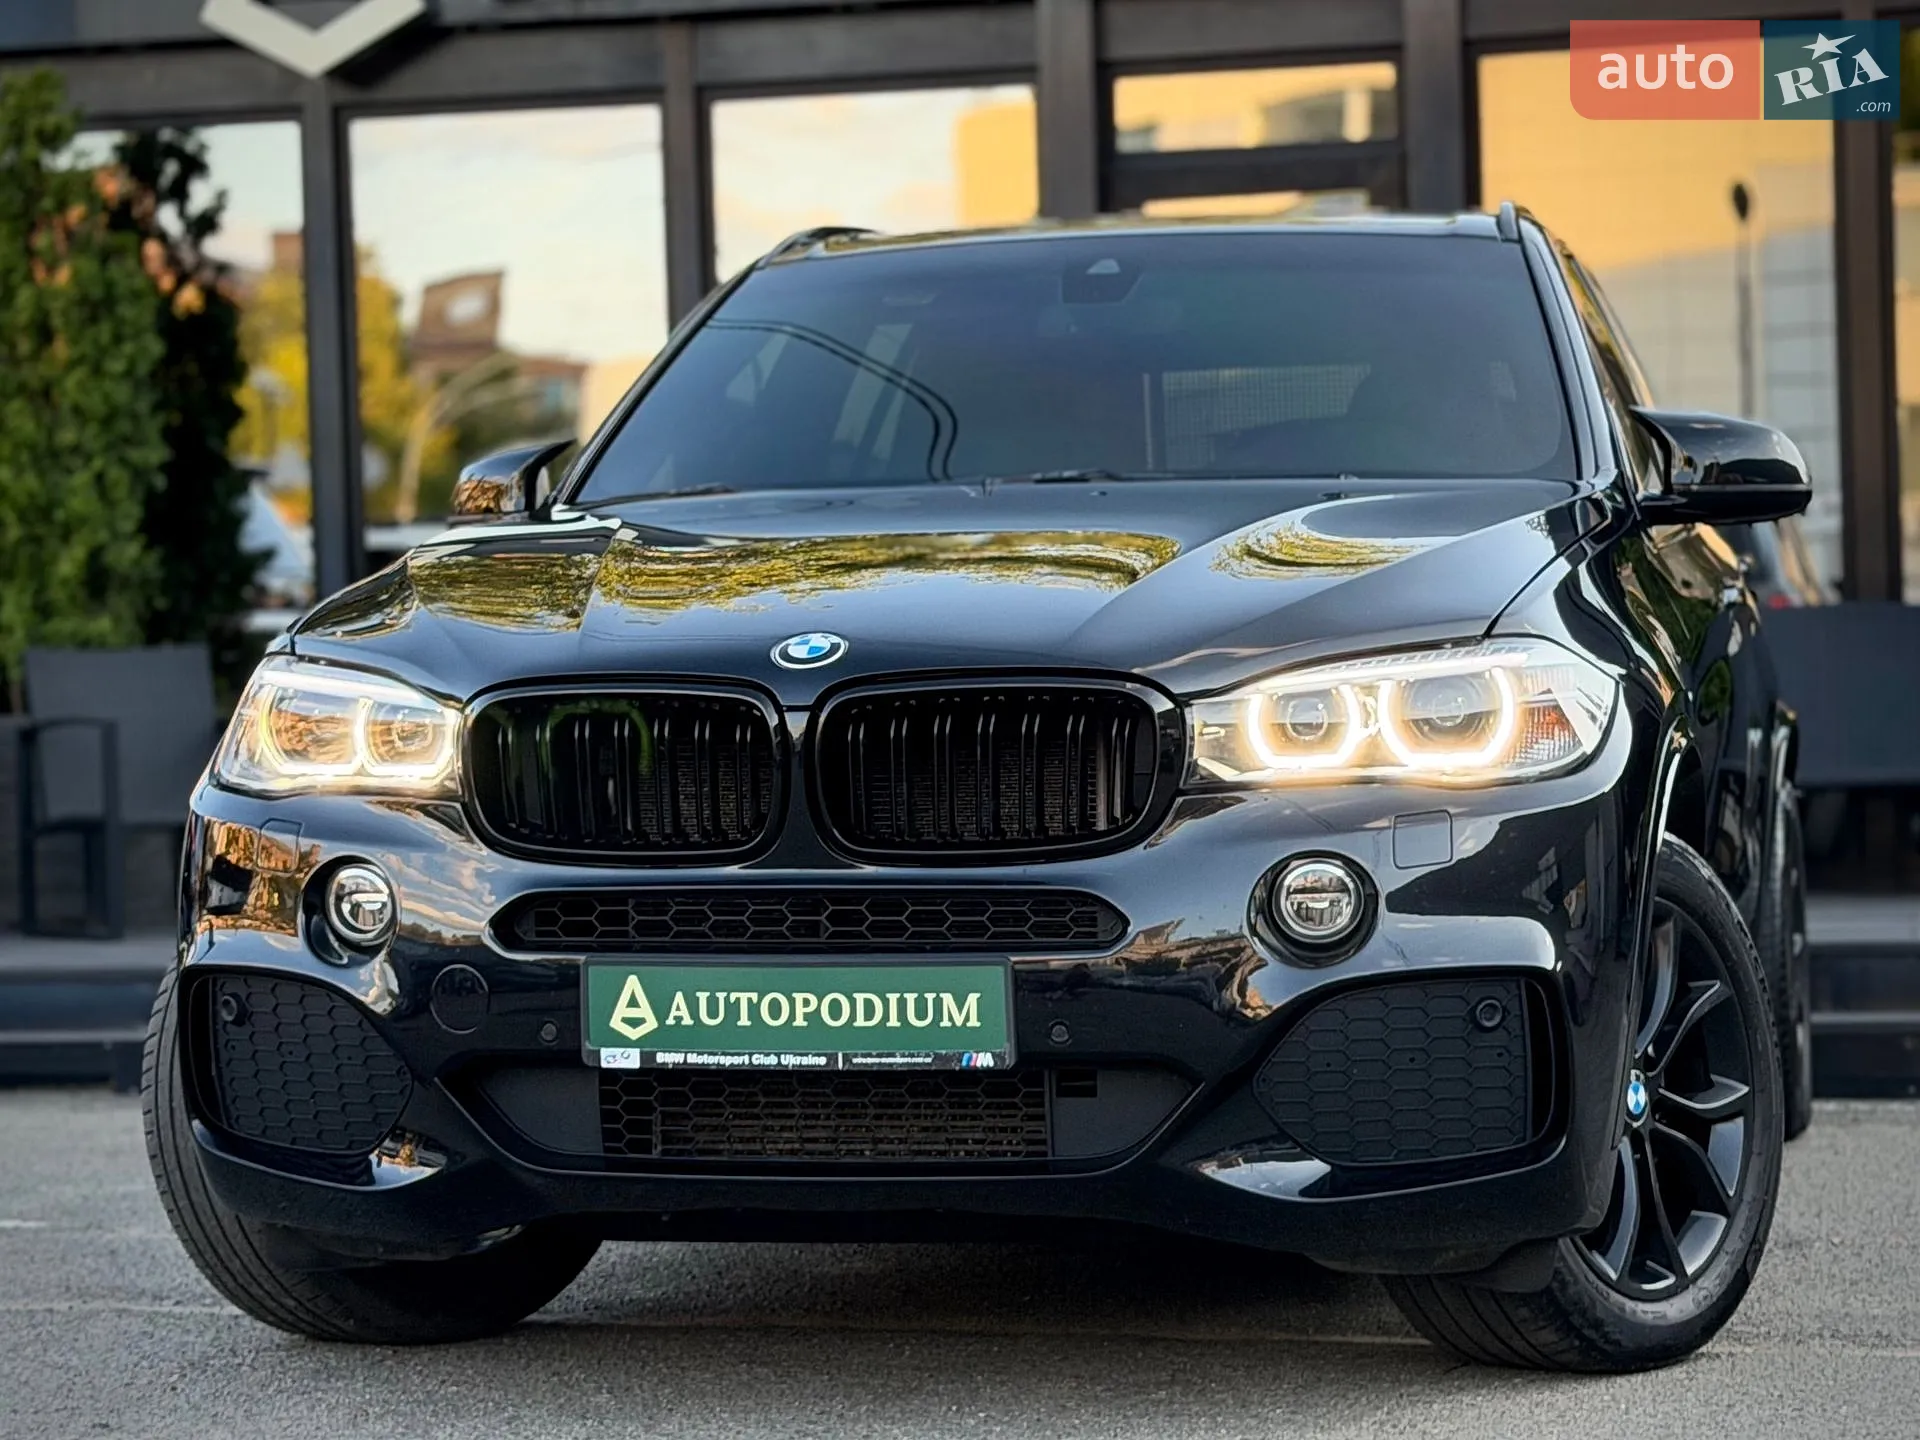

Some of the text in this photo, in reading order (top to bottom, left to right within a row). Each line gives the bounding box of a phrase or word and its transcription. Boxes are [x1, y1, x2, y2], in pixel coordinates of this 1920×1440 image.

[664, 990, 982, 1028] AUTOPODIUM
[656, 1051, 827, 1068] BMW Motorsport Club Ukraine
